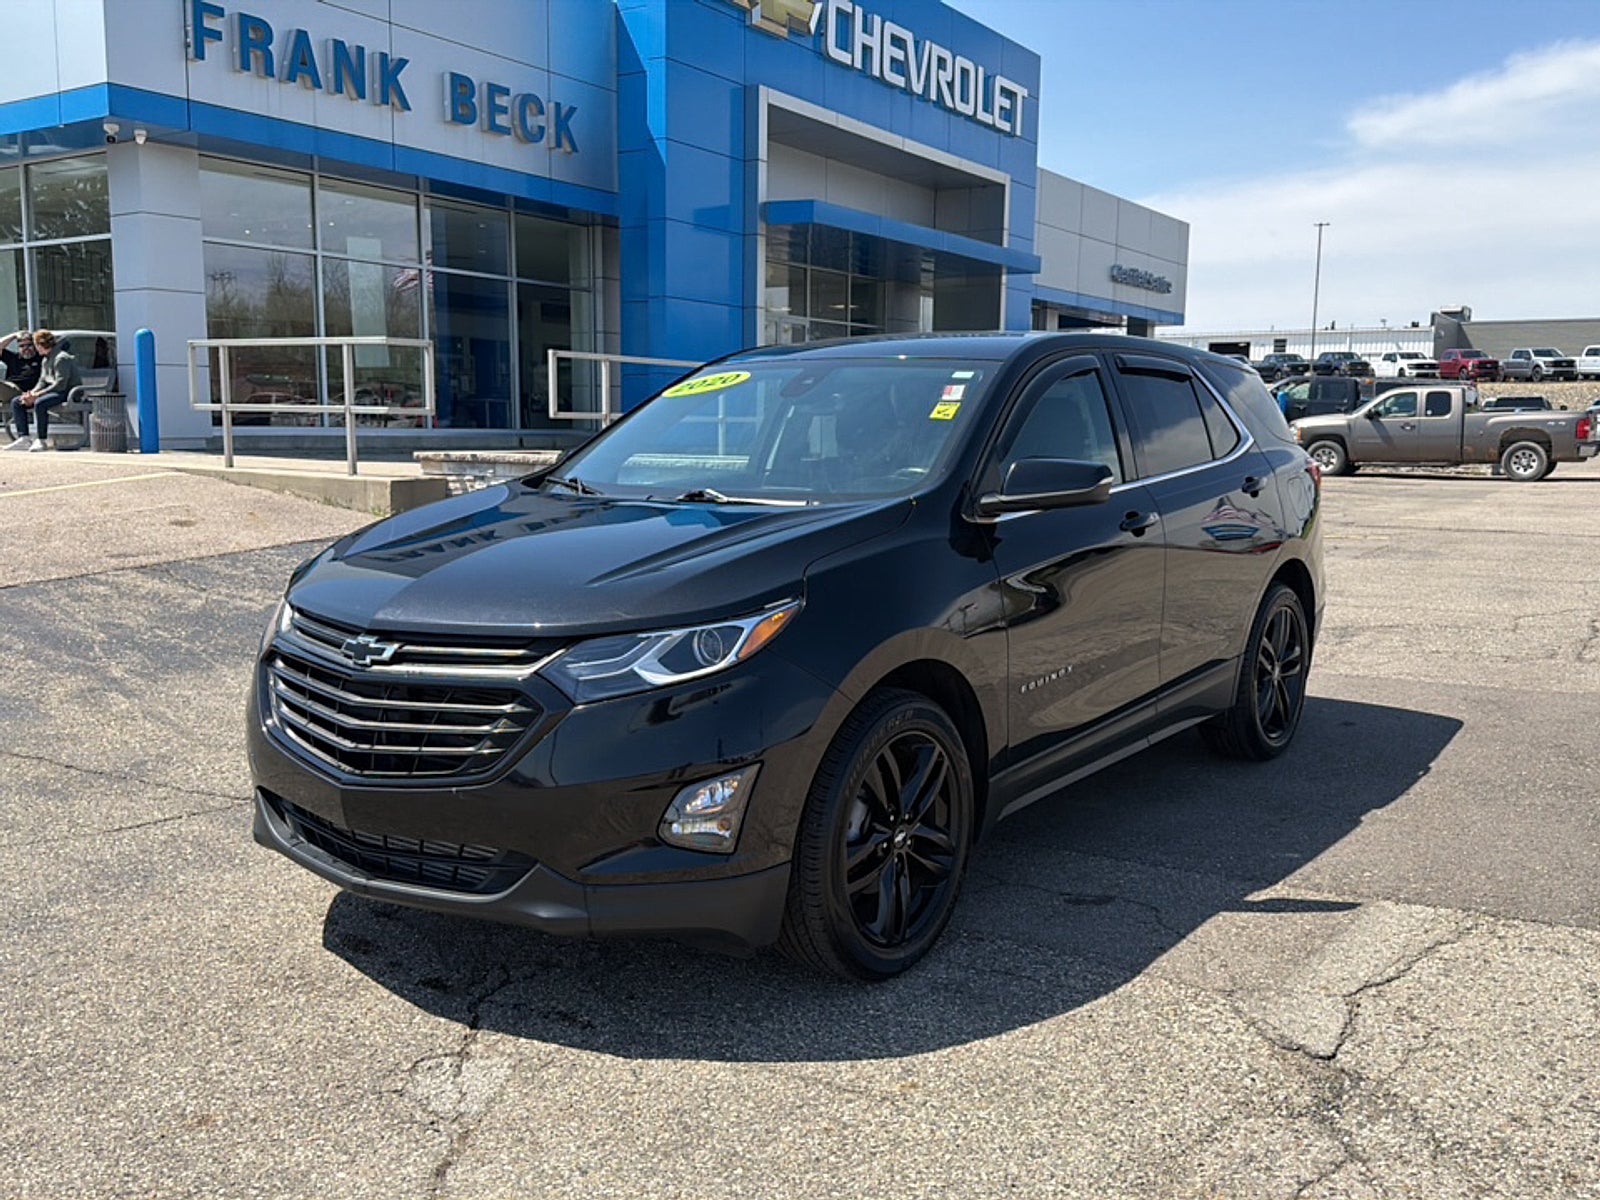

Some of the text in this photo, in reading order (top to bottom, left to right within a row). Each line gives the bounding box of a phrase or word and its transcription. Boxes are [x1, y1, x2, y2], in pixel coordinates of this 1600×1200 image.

[186, 0, 578, 154] FRANK BECK
[826, 0, 1028, 137] CHEVROLET
[672, 373, 742, 393] 2020
